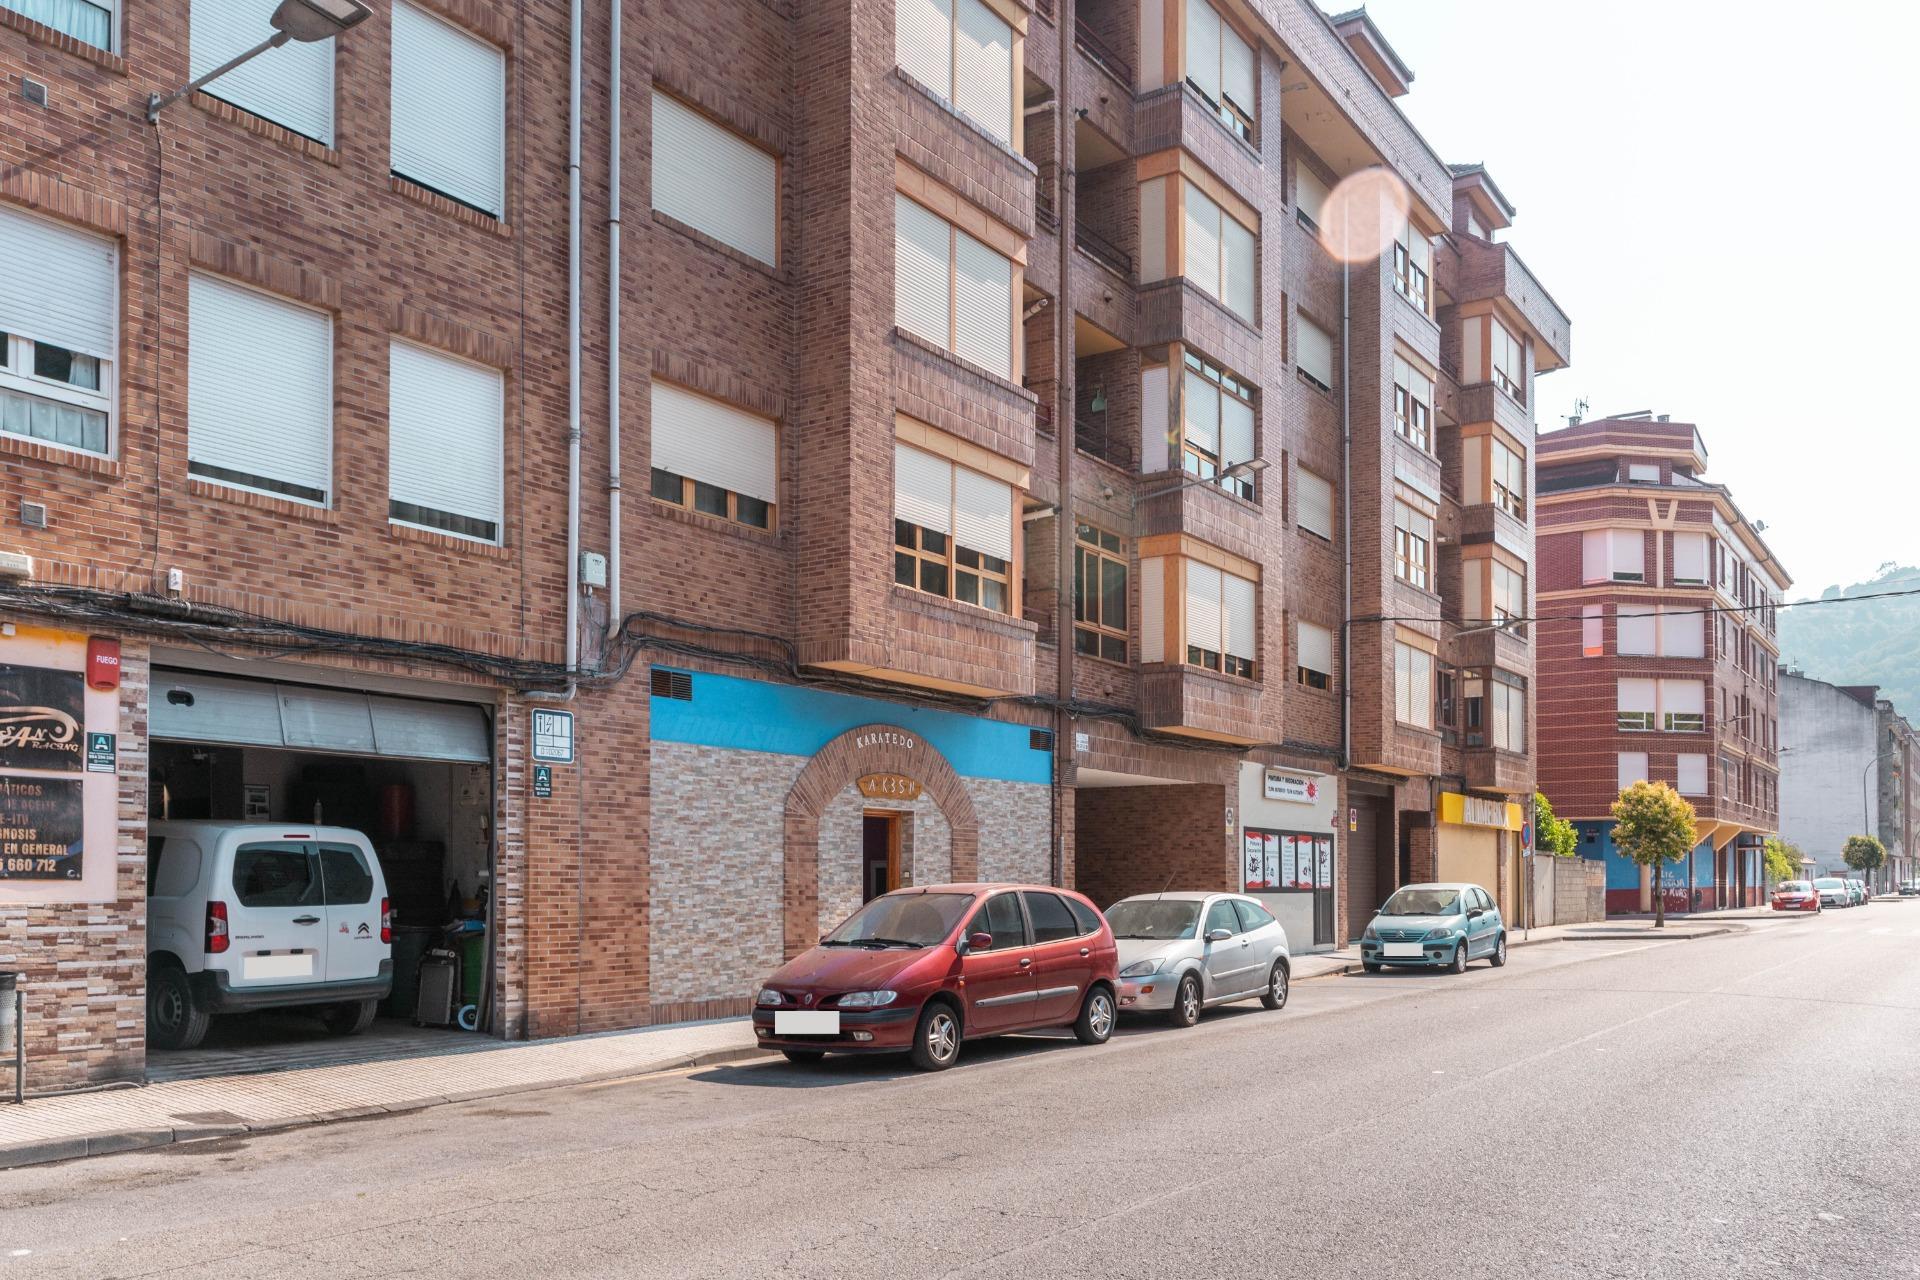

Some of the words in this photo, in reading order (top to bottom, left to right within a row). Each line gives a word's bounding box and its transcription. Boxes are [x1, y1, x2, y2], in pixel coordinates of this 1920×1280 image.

[96, 655, 118, 665] FUEGO
[857, 733, 913, 749] KARATEDO
[0, 828, 37, 840] NOSIS
[4, 843, 18, 855] EN
[21, 843, 69, 856] GENERAL
[7, 858, 33, 872] 660
[36, 859, 57, 872] 712
